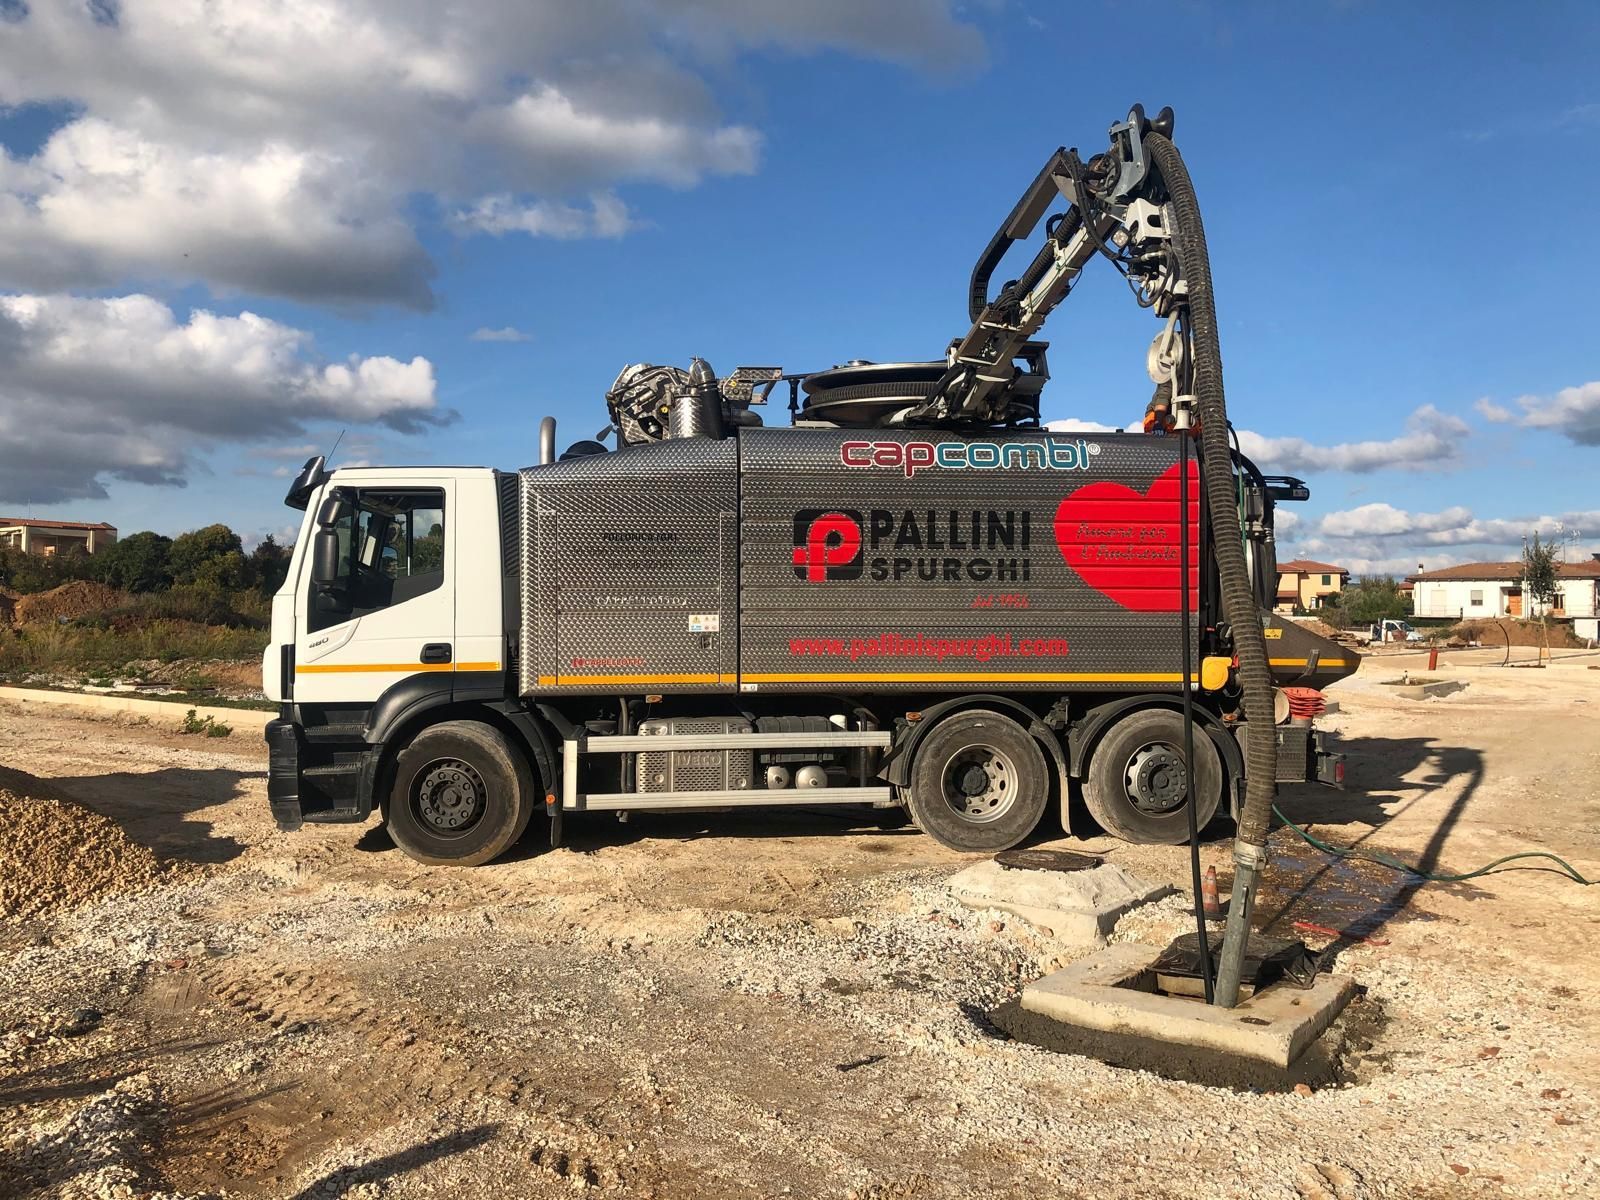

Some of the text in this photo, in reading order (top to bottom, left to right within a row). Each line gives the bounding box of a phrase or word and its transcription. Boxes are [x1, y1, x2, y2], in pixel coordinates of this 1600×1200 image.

[870, 510, 1030, 550] PALLINI
[1139, 527, 1167, 543] per
[870, 558, 1030, 581] SPURGHI
[788, 633, 1069, 662] www.pallinispurghi.com
